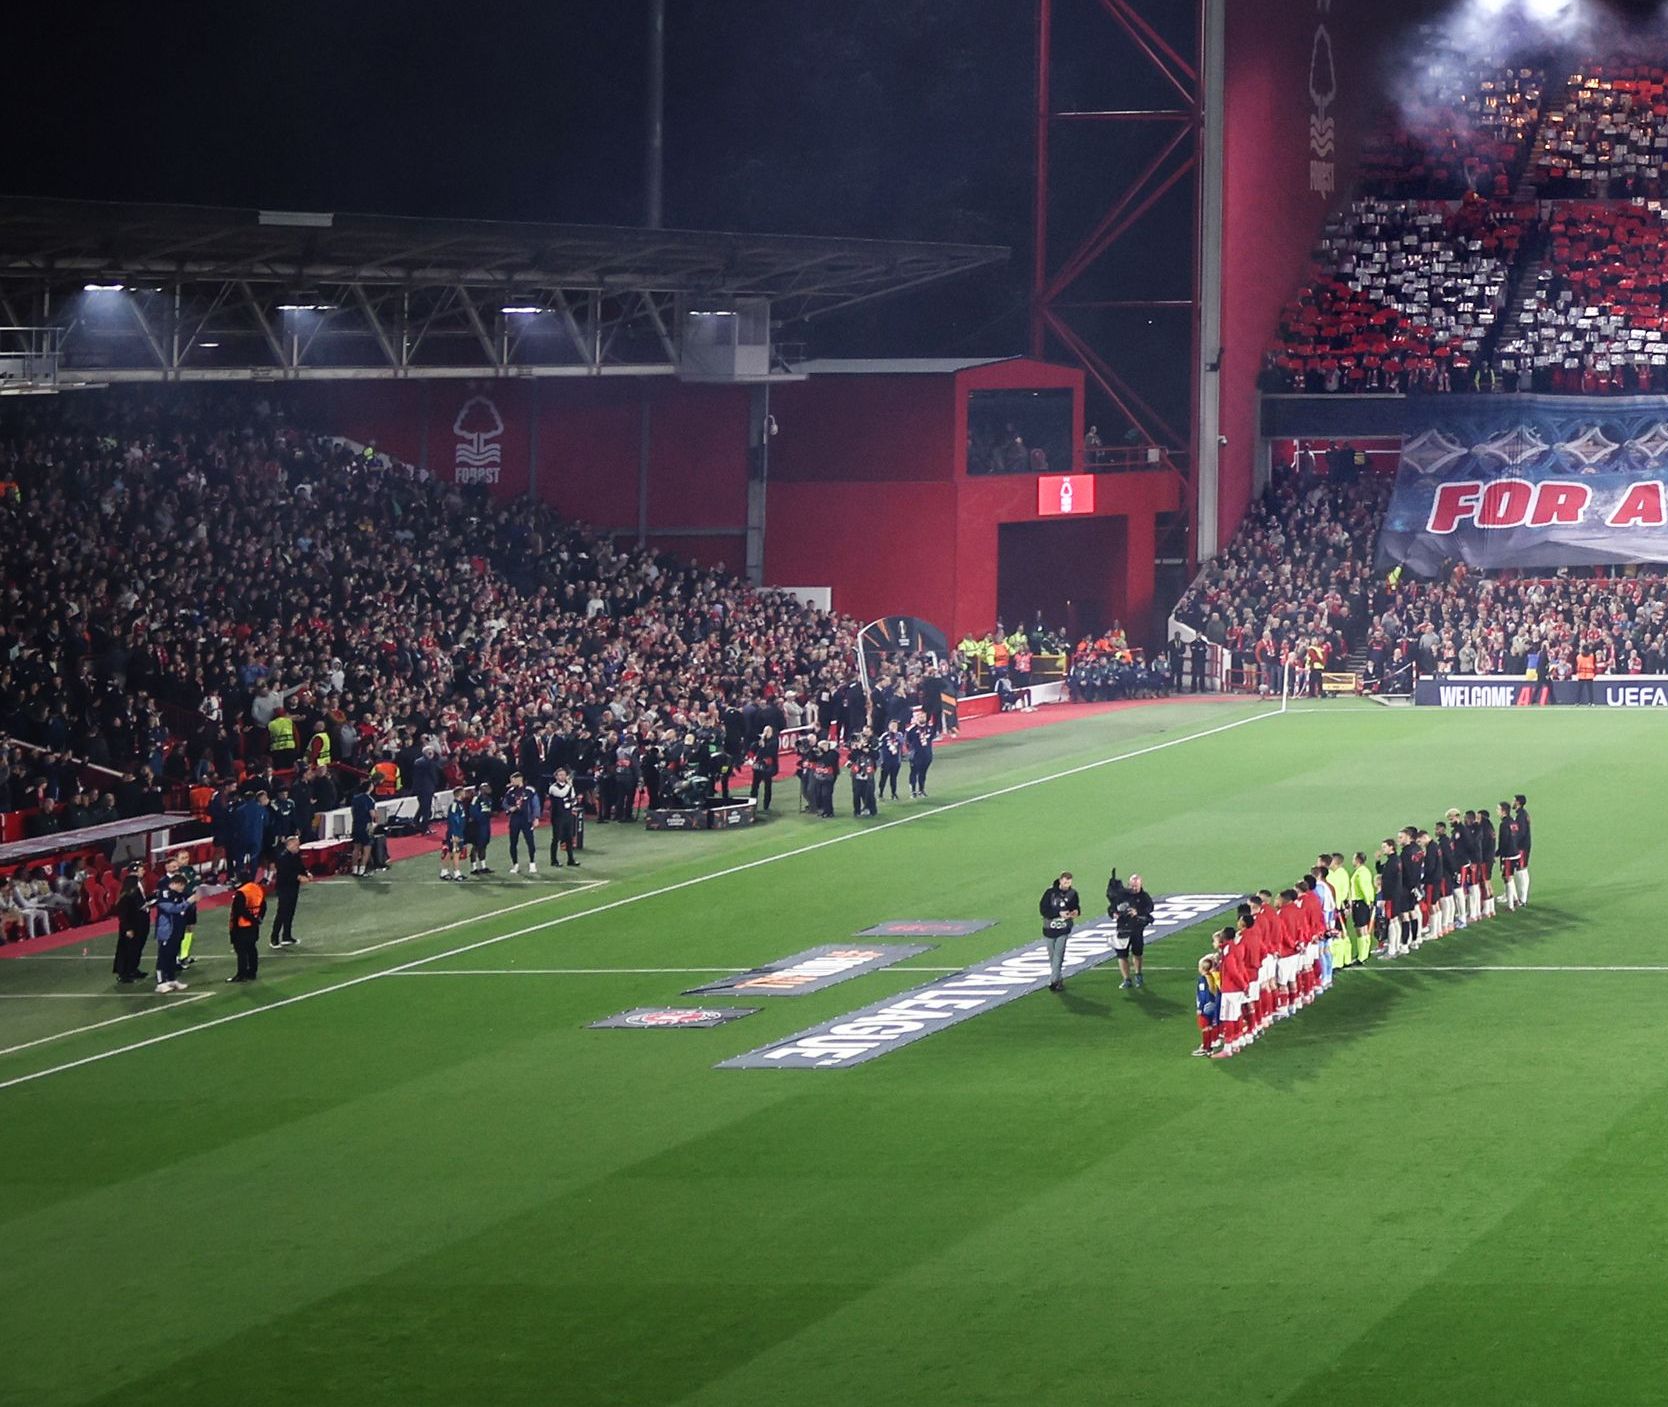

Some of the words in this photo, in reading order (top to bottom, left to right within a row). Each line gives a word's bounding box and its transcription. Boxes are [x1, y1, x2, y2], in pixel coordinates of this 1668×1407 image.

[1426, 477, 1591, 534] FOR
[1605, 480, 1667, 527] A
[1440, 686, 1515, 707] WELCOME
[1516, 687, 1549, 707] AL
[1607, 687, 1668, 706] UEFA
